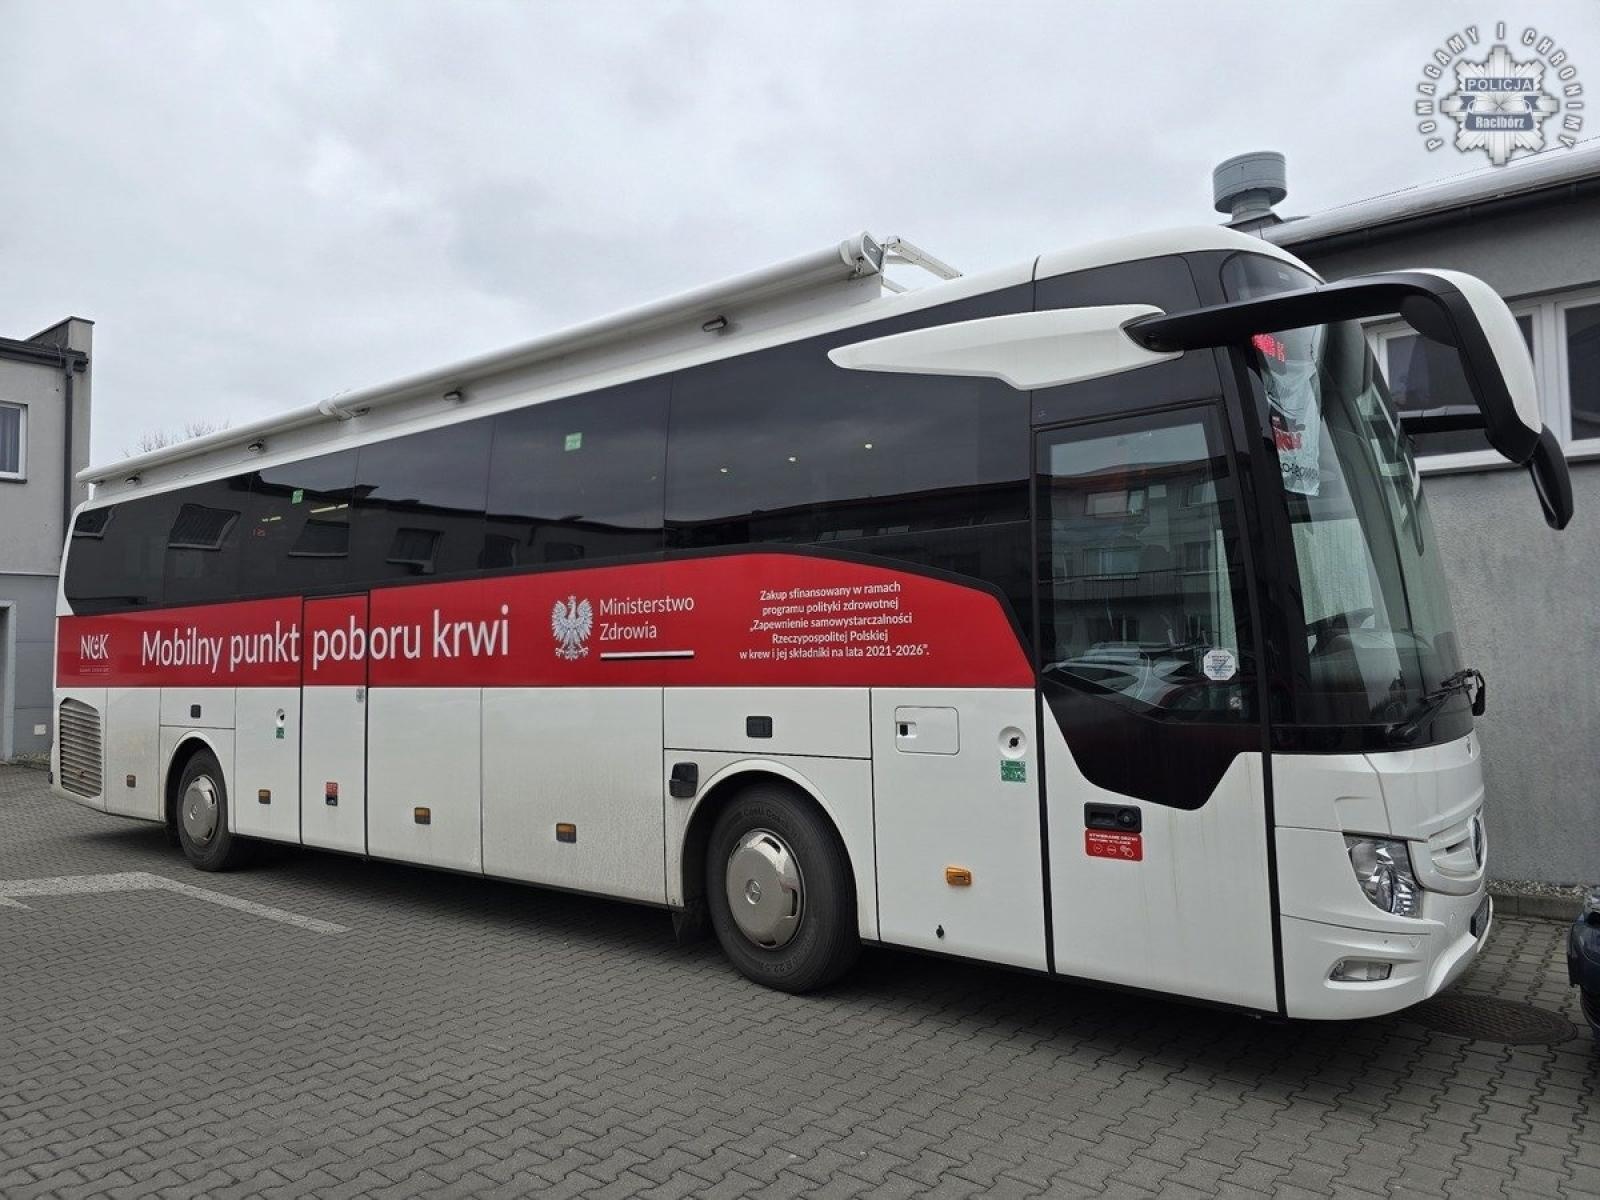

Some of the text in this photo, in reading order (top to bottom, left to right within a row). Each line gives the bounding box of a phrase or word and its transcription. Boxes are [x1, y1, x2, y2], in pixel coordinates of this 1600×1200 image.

[759, 581, 901, 602] Zakup sfinansowany w ramach
[599, 595, 694, 616] Ministerstwo
[762, 597, 899, 616] programu polityki zdrowotnej
[599, 620, 657, 641] Zdrowia
[810, 613, 912, 628] samowystarczalności
[141, 604, 509, 674] Mobilny punkt poboru krwi
[772, 629, 888, 645] Rzeczypospolitej Polskiej
[739, 651, 748, 660] w
[748, 648, 770, 660] krew
[776, 648, 788, 661] jej
[789, 646, 830, 659] składniki
[831, 648, 844, 657] na
[845, 646, 864, 657] lata
